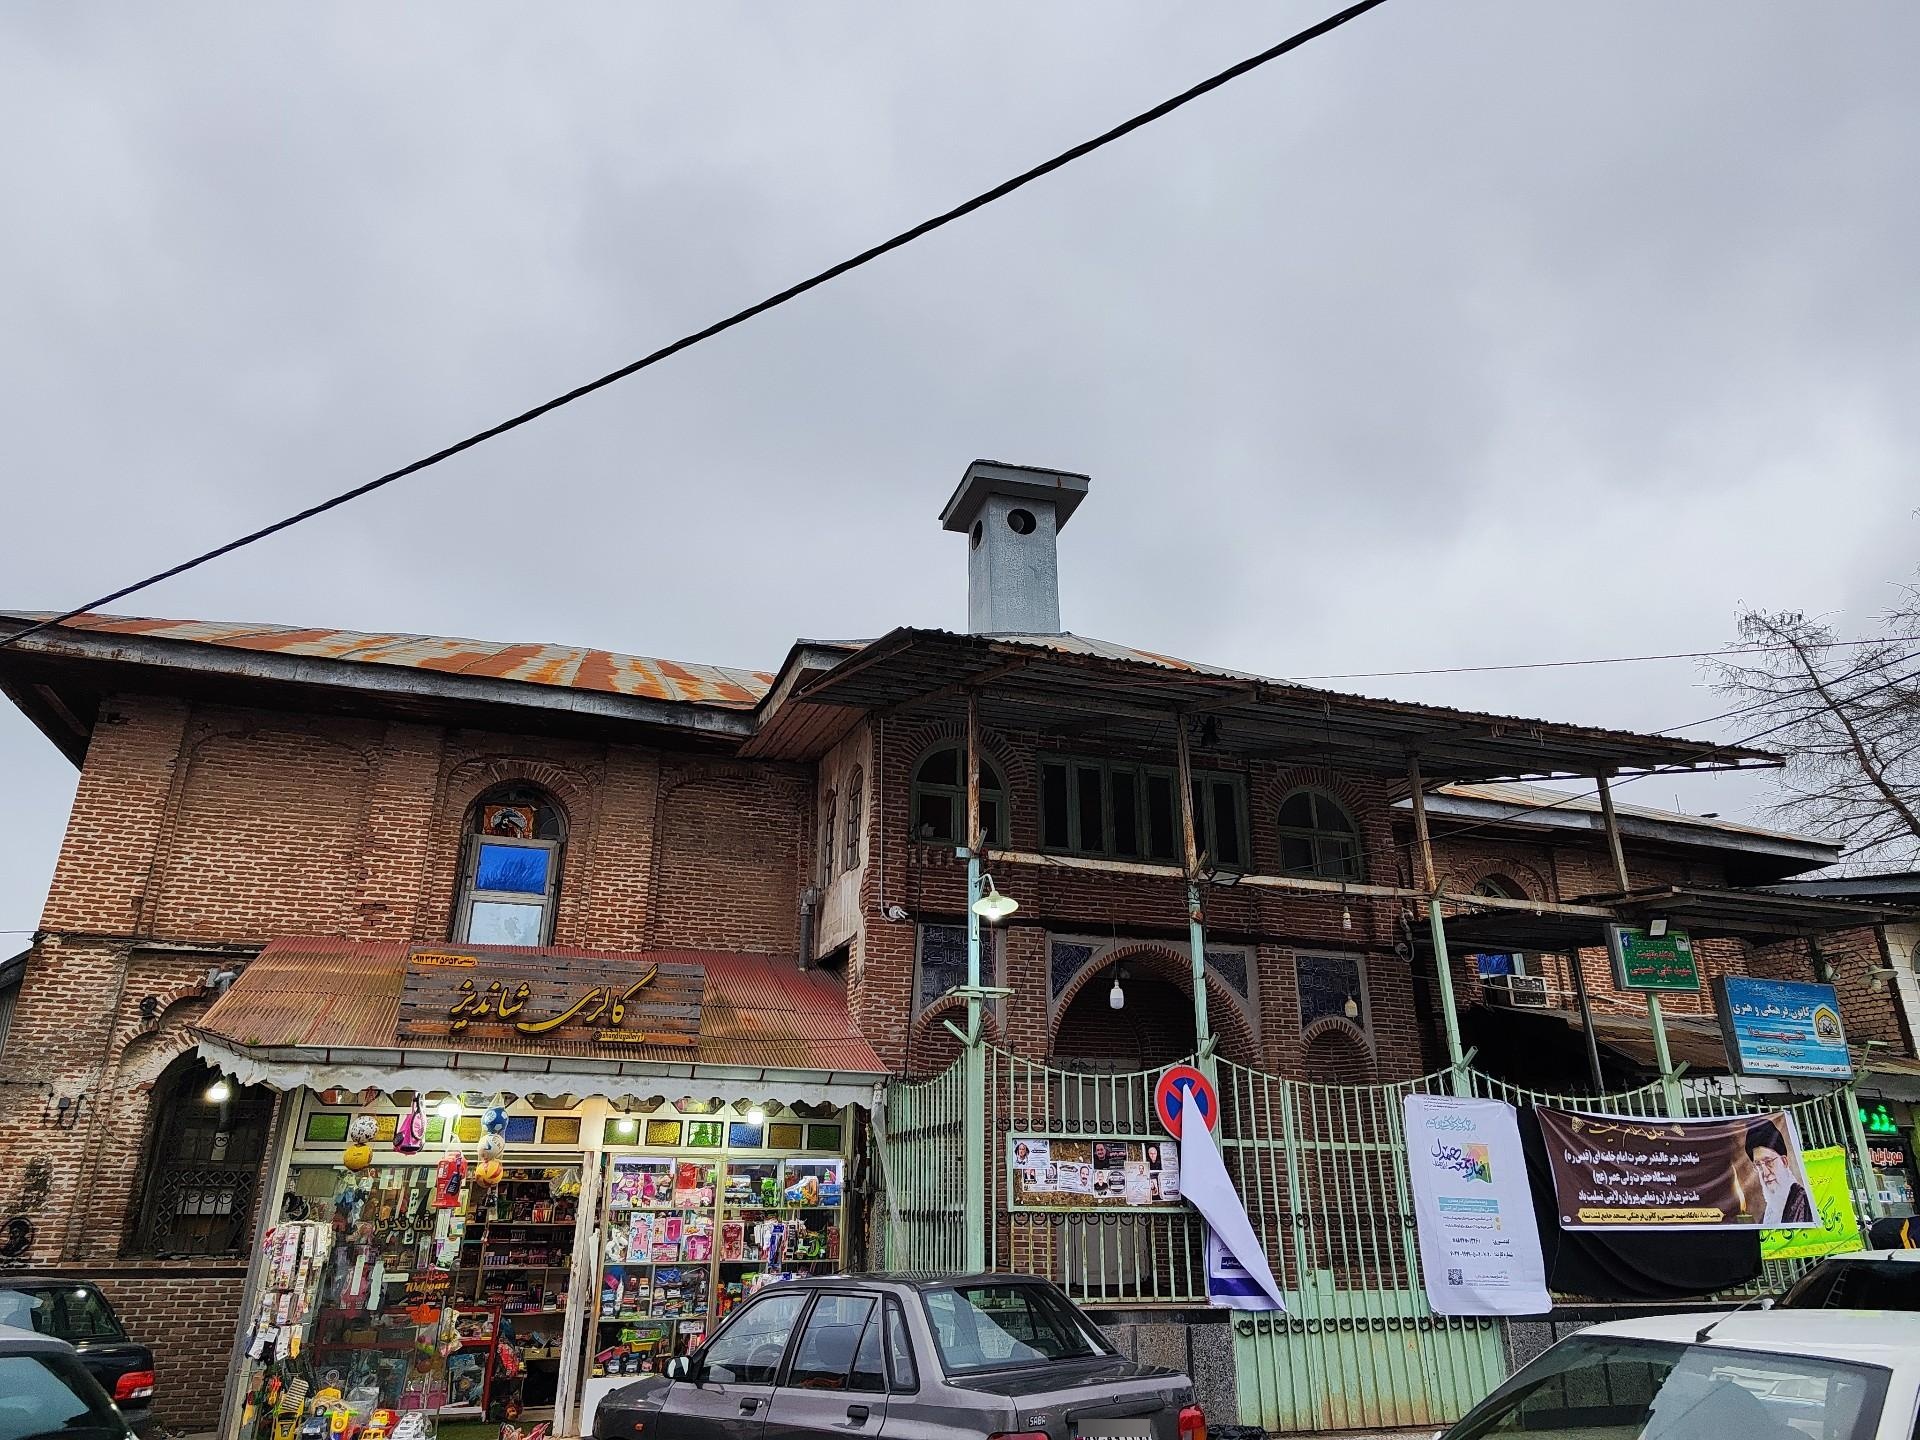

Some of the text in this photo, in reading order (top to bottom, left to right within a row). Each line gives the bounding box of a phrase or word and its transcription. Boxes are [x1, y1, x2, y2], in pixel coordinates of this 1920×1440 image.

[450, 979, 532, 1032] شاندیز
[1732, 1002, 1811, 1020] کانون فرهنگی و هنری
[1616, 1150, 1628, 1165] امام
[1628, 1151, 1648, 1166] حضرت
[1648, 1151, 1669, 1166] عالیقدر
[1668, 1153, 1681, 1166] رهبر
[1681, 1151, 1700, 1165] شهادت
[1592, 1169, 1607, 1185] (عج)
[1608, 1172, 1621, 1186] عصر
[1620, 1169, 1634, 1186] ولی
[1633, 1170, 1652, 1186] حضرت
[1652, 1170, 1671, 1186] پیشگاه
[1578, 1189, 1587, 1204] باد
[1586, 1189, 1604, 1204] تسلیت
[1659, 1190, 1674, 1205] ایران
[1673, 1190, 1689, 1205] شریف
[1689, 1190, 1700, 1202] ملت
[1600, 1211, 1613, 1222] جامع
[1612, 1212, 1627, 1221] مسجد
